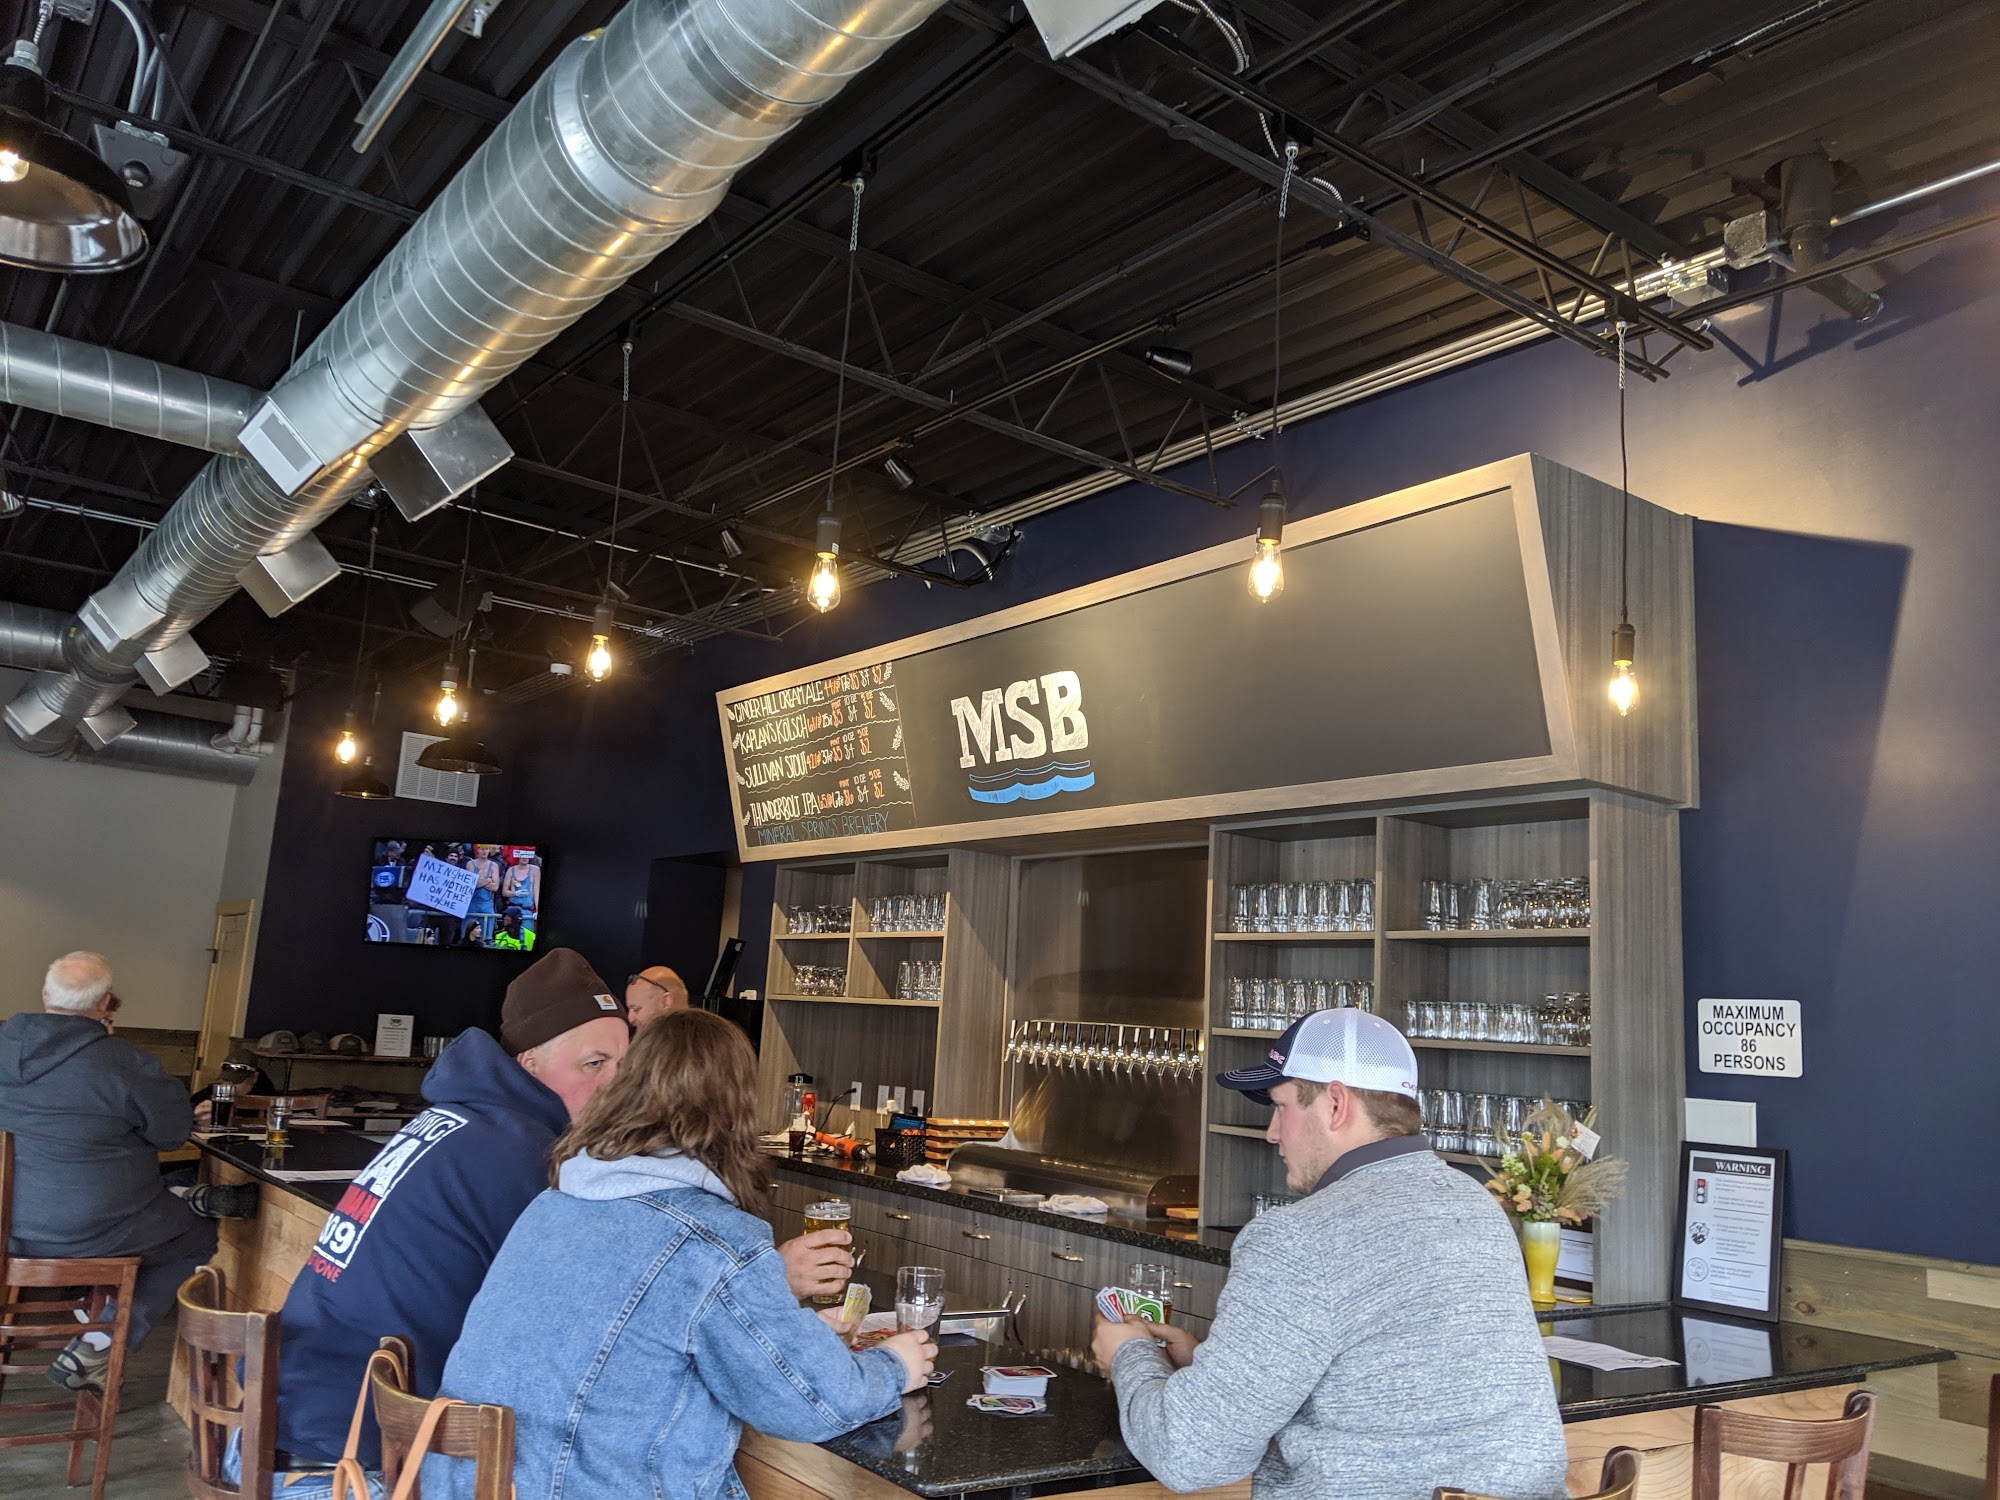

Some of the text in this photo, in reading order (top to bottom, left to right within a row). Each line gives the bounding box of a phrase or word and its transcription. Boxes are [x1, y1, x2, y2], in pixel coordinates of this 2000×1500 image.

[734, 697, 762, 723] CINDER
[760, 693, 780, 717] HILL
[779, 686, 805, 709] CREAM
[805, 681, 824, 705] ALE
[775, 713, 809, 744] KÖLSCH
[832, 709, 843, 728] $5
[848, 705, 858, 722] $4
[863, 700, 876, 719] $2
[951, 671, 1088, 768] MSB
[744, 756, 784, 788] SULLIVAN
[784, 751, 808, 778] STOUT
[832, 746, 843, 762] $5
[844, 743, 855, 760] $4
[859, 737, 872, 755] $2
[750, 795, 800, 826] THUNDERBOLT
[801, 791, 821, 815] IPA
[857, 785, 869, 803] $4
[873, 781, 885, 799] $2
[757, 811, 889, 845] MINERAL SPRINGS BREWERY
[419, 872, 440, 885] HAS
[430, 885, 469, 904] ON THIS
[1713, 1005, 1784, 1020] MAXIMUM
[1702, 1021, 1796, 1037] OCCUPANCY
[1741, 1038, 1757, 1053] 86
[1714, 1053, 1786, 1071] PERSONS
[1715, 1161, 1766, 1175] WARNING
